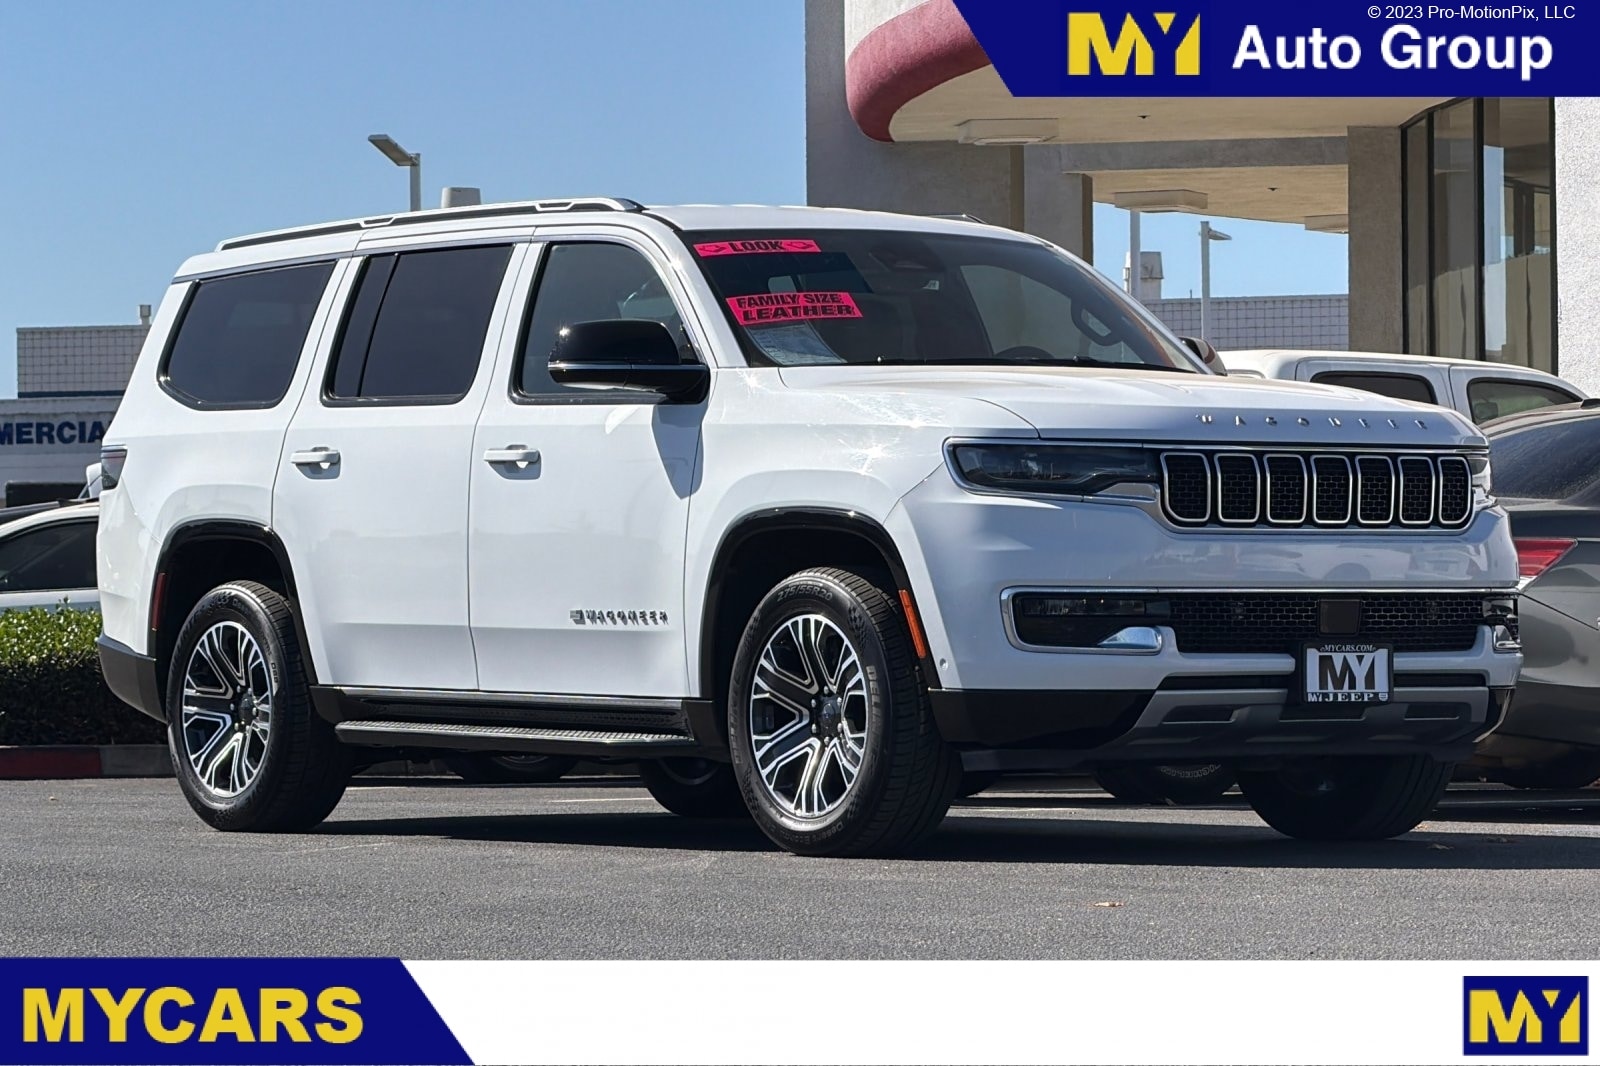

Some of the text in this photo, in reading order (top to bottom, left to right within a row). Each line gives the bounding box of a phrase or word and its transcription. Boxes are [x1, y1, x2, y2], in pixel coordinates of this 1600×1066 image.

[728, 240, 785, 252] LOOK
[736, 293, 842, 309] FAMILY SIZE
[743, 305, 854, 322] LEATHER
[1318, 654, 1376, 691] MY
[1324, 692, 1374, 702] JEEP
